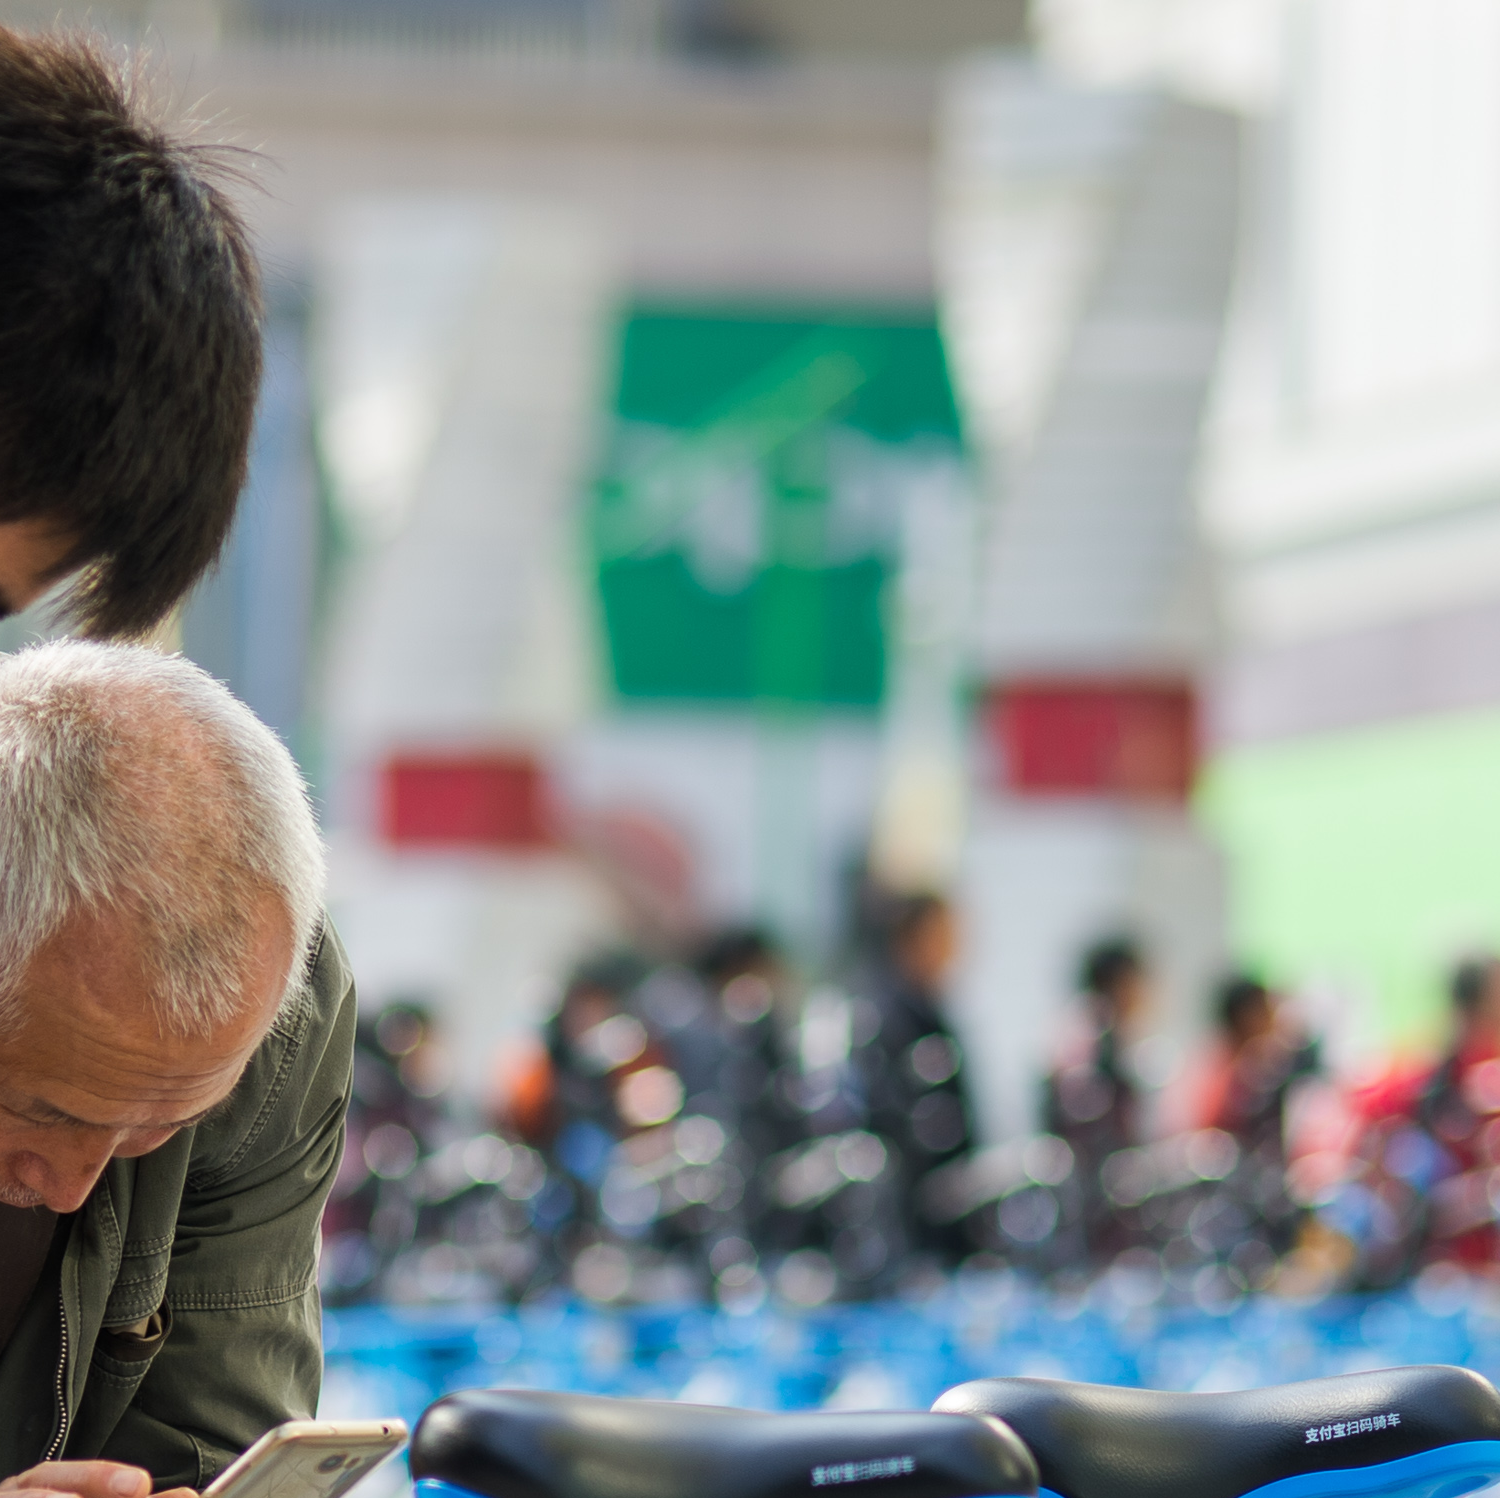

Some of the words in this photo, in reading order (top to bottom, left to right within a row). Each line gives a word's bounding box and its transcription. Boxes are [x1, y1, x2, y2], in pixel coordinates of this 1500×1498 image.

[1305, 1412, 1401, 1444] 支付宝扫码骑车
